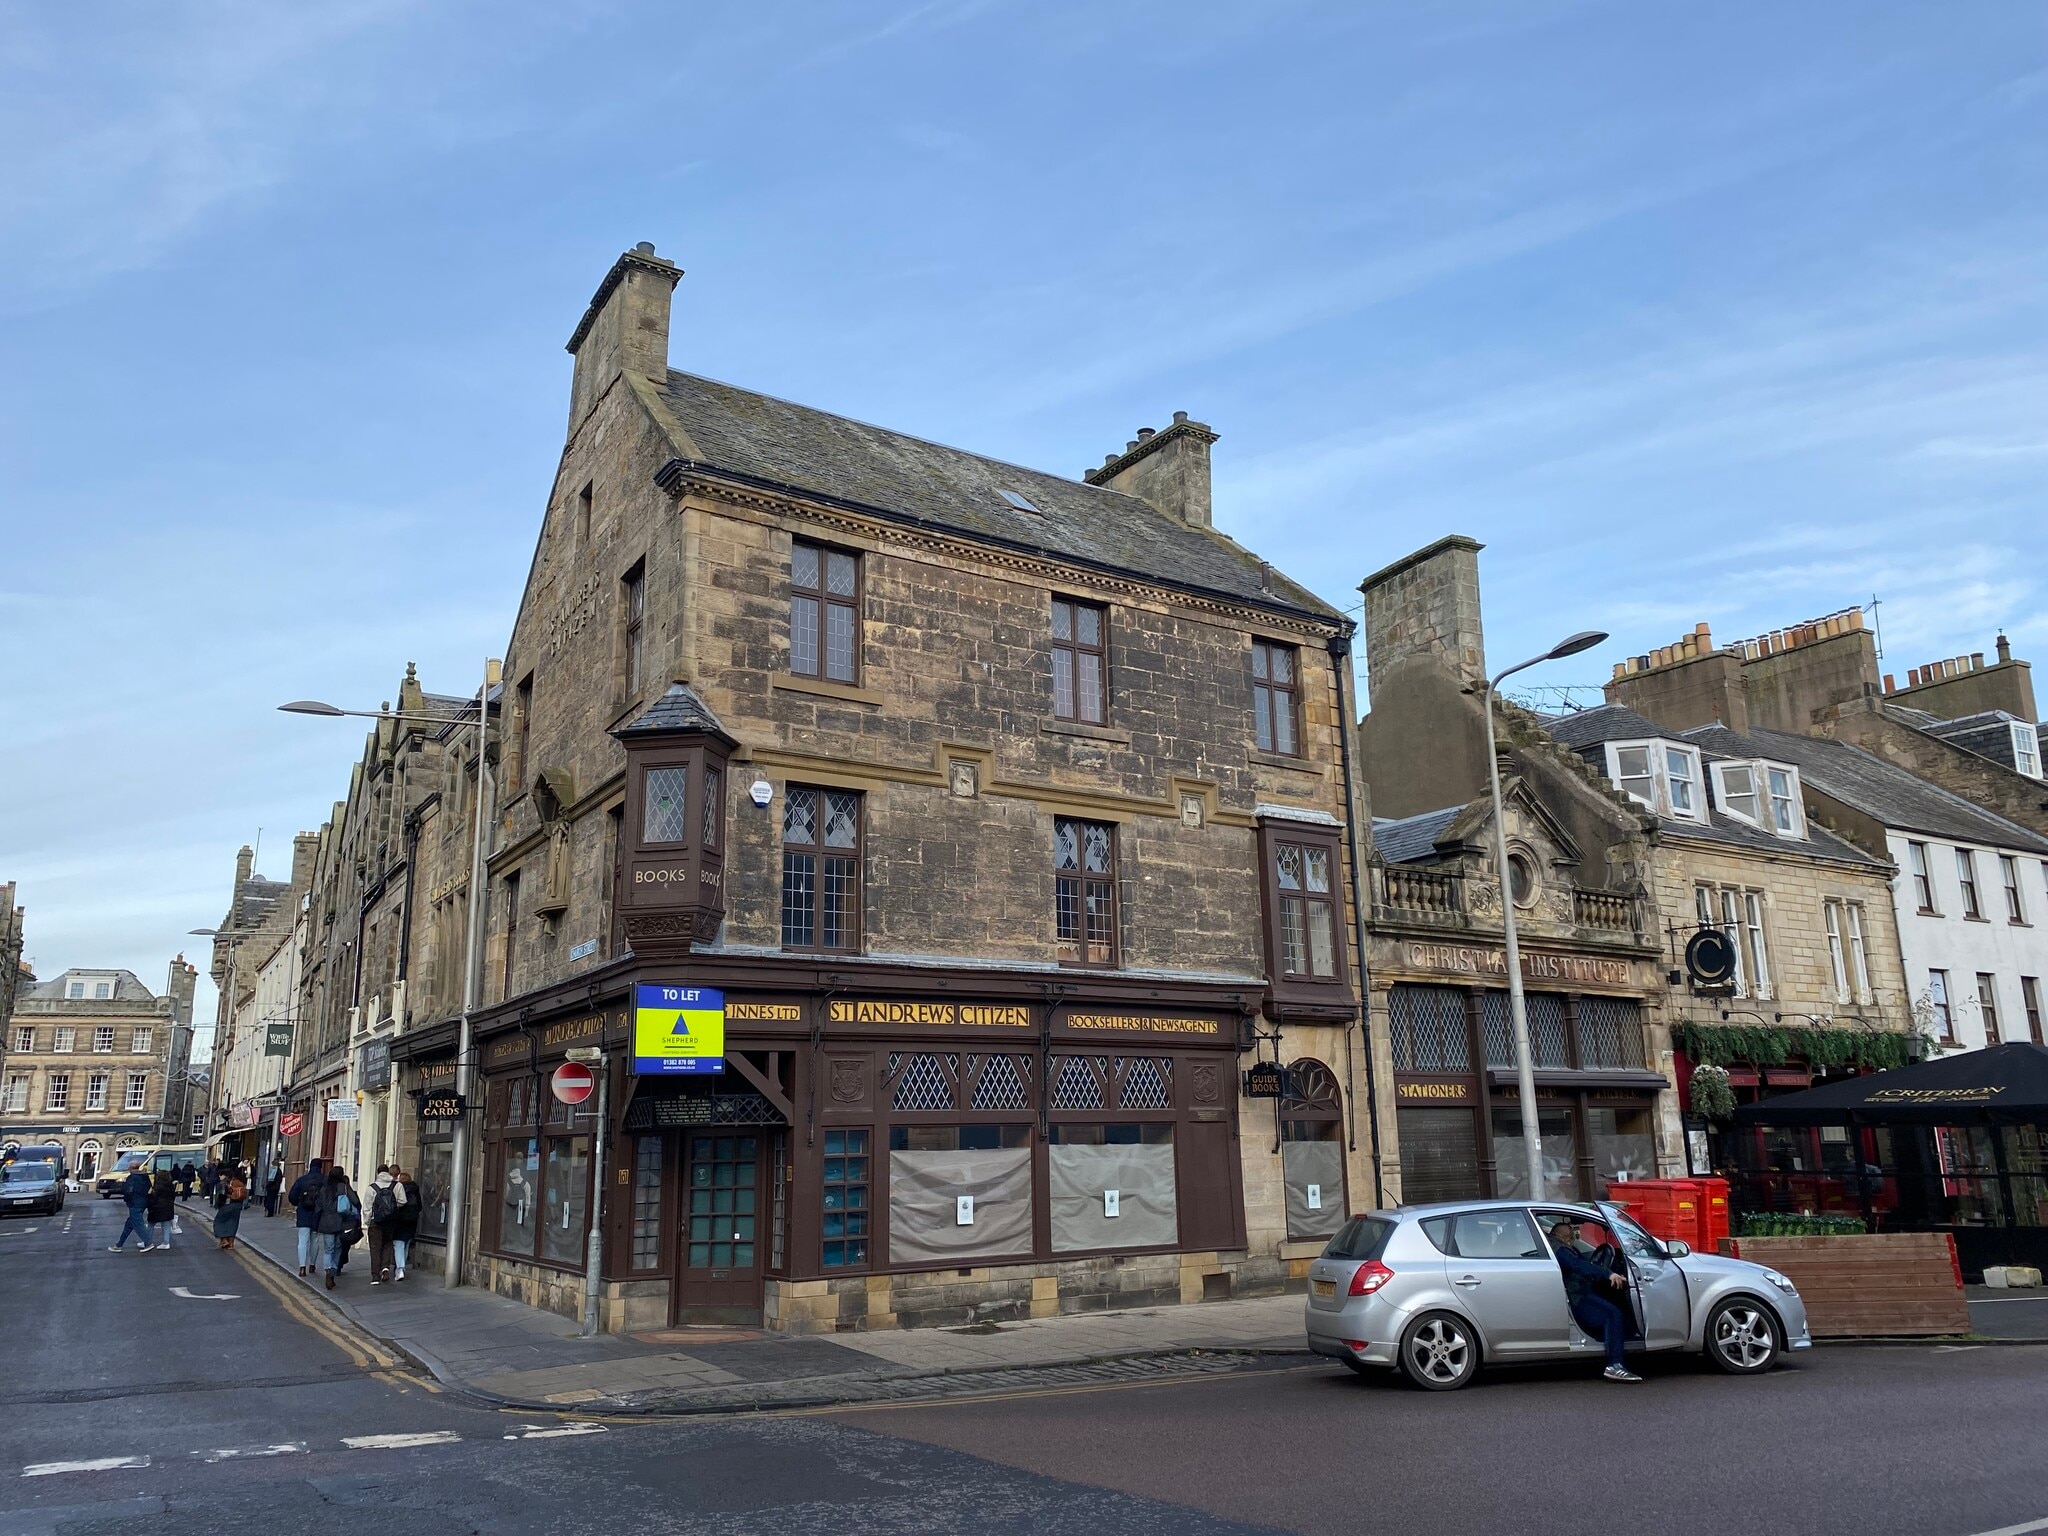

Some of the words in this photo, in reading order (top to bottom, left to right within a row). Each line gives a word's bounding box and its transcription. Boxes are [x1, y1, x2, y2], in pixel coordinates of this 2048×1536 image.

[635, 869, 686, 884] BOOKS
[700, 869, 720, 888] BOOKS
[1410, 944, 1510, 974] CHRISTIA
[1529, 955, 1628, 983] INSTITUTE
[1693, 936, 1726, 978] C
[662, 989, 678, 1000] TO
[681, 989, 701, 1001] LET
[732, 1004, 774, 1019] INNES
[777, 1008, 799, 1020] LTD
[830, 1002, 853, 1021] ST
[859, 1003, 954, 1023] ANDREWS
[960, 1006, 1029, 1026] CITIZEN
[1069, 1015, 1140, 1030] BOOKSELLERS
[1142, 1018, 1149, 1030] &
[1152, 1019, 1217, 1033] NEWSAGENTS
[1251, 1075, 1278, 1084] GUIDE
[1252, 1083, 1280, 1093] BOOKS
[1399, 1085, 1466, 1098] STATIONERS
[1880, 1086, 2007, 1097] CRITERION
[428, 1099, 458, 1108] POST
[423, 1107, 460, 1116] CARDS
